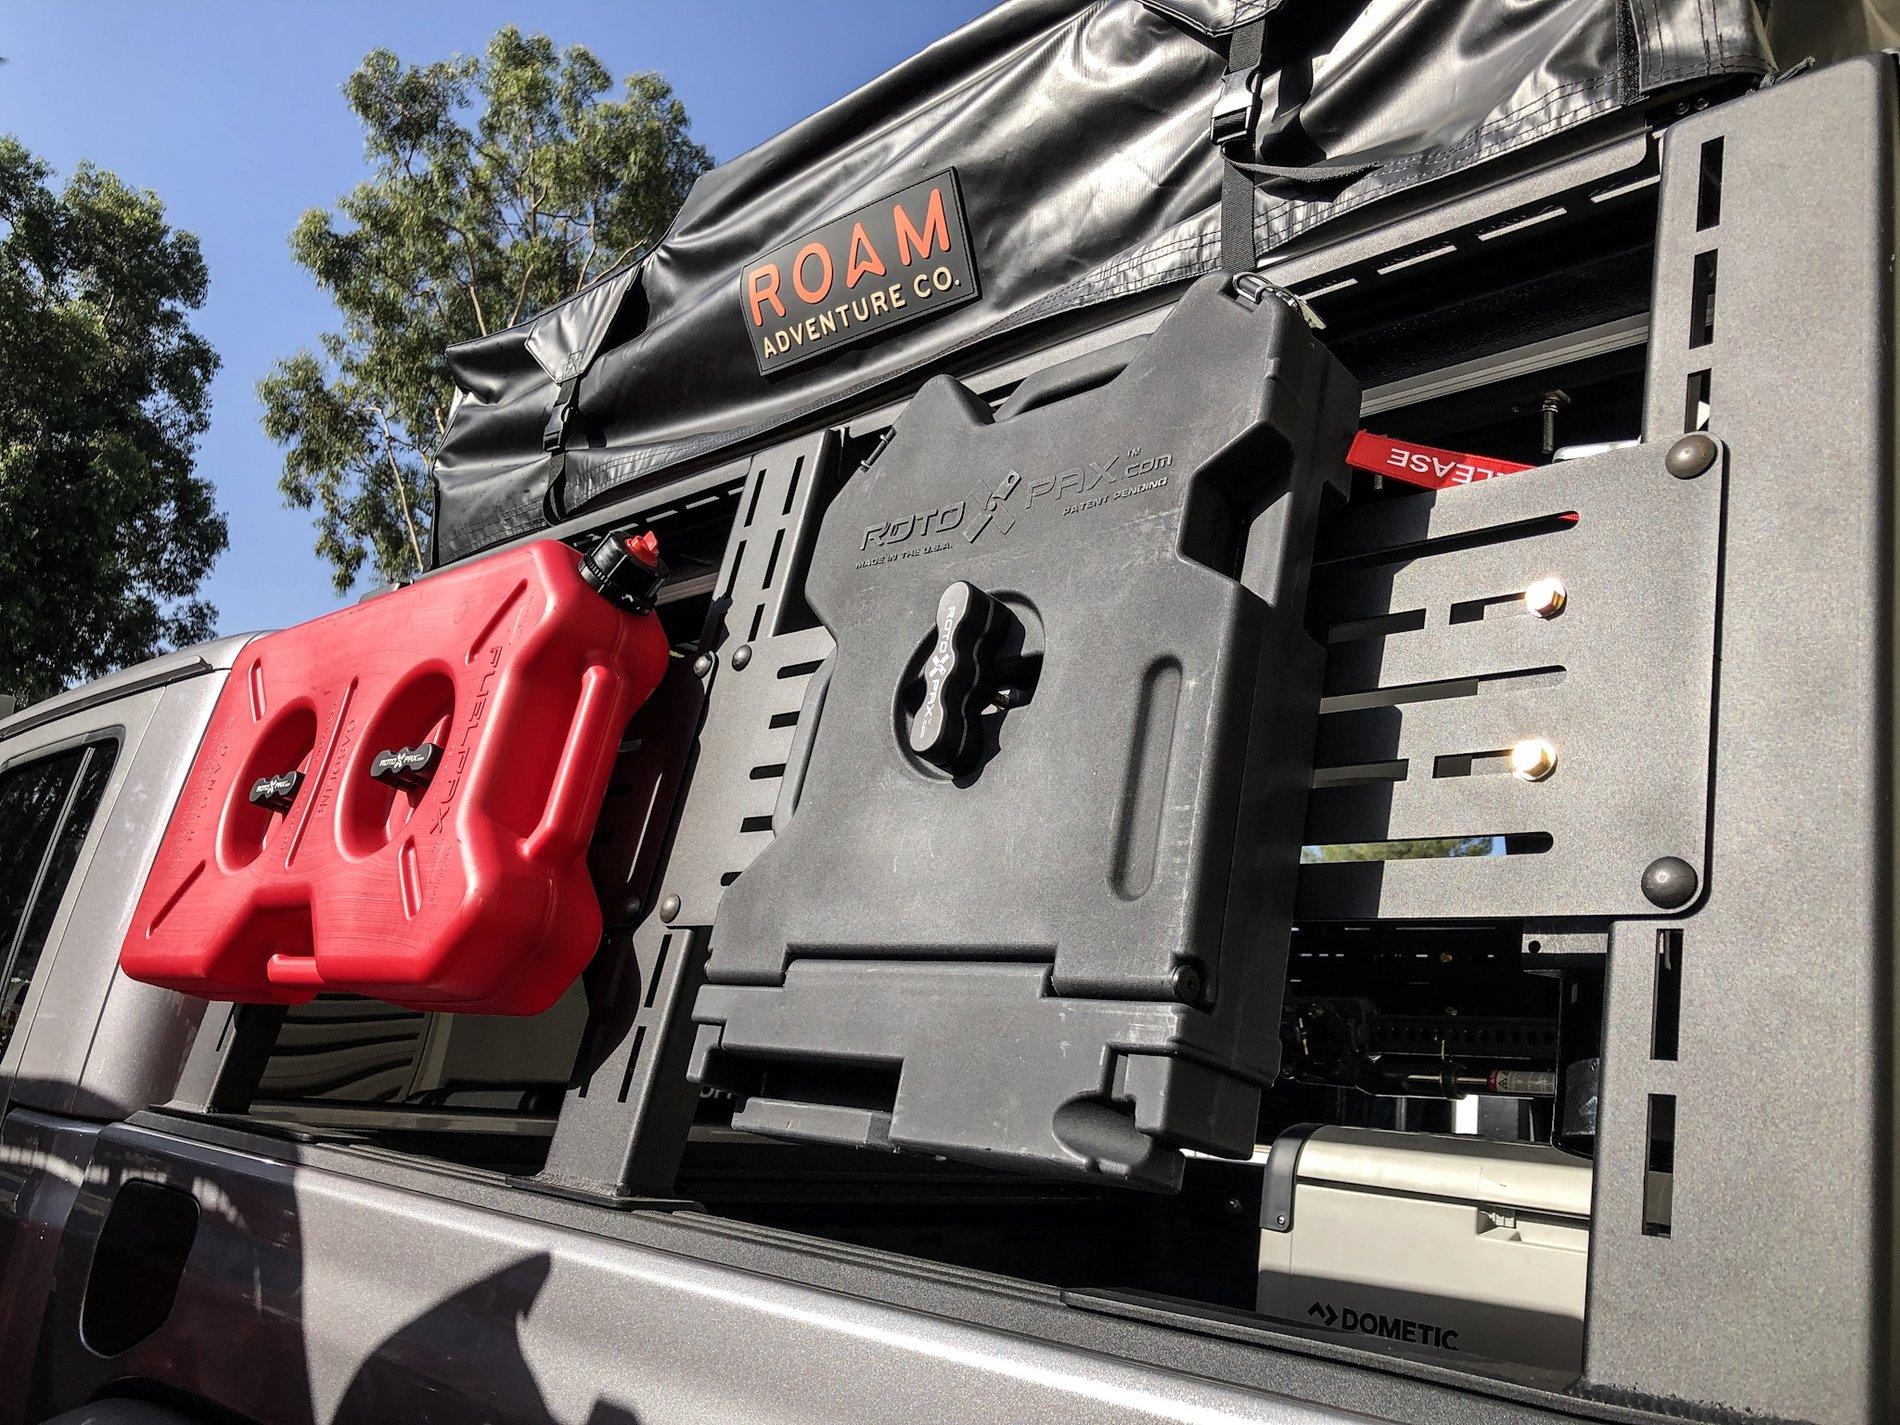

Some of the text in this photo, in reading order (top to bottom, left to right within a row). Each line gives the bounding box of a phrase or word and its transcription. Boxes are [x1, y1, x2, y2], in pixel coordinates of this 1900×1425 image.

[748, 188, 951, 328] ROAM
[763, 266, 961, 359] ADVENTURE CO.
[1386, 447, 1505, 484] LEASE
[1062, 477, 1168, 516] PATENT PENDING
[860, 501, 966, 551] ROTO
[856, 557, 885, 570] MADE
[888, 554, 898, 562] IN
[901, 549, 921, 559] THE
[939, 606, 957, 653] ROTO
[1342, 1307, 1459, 1351] DOMETIC
